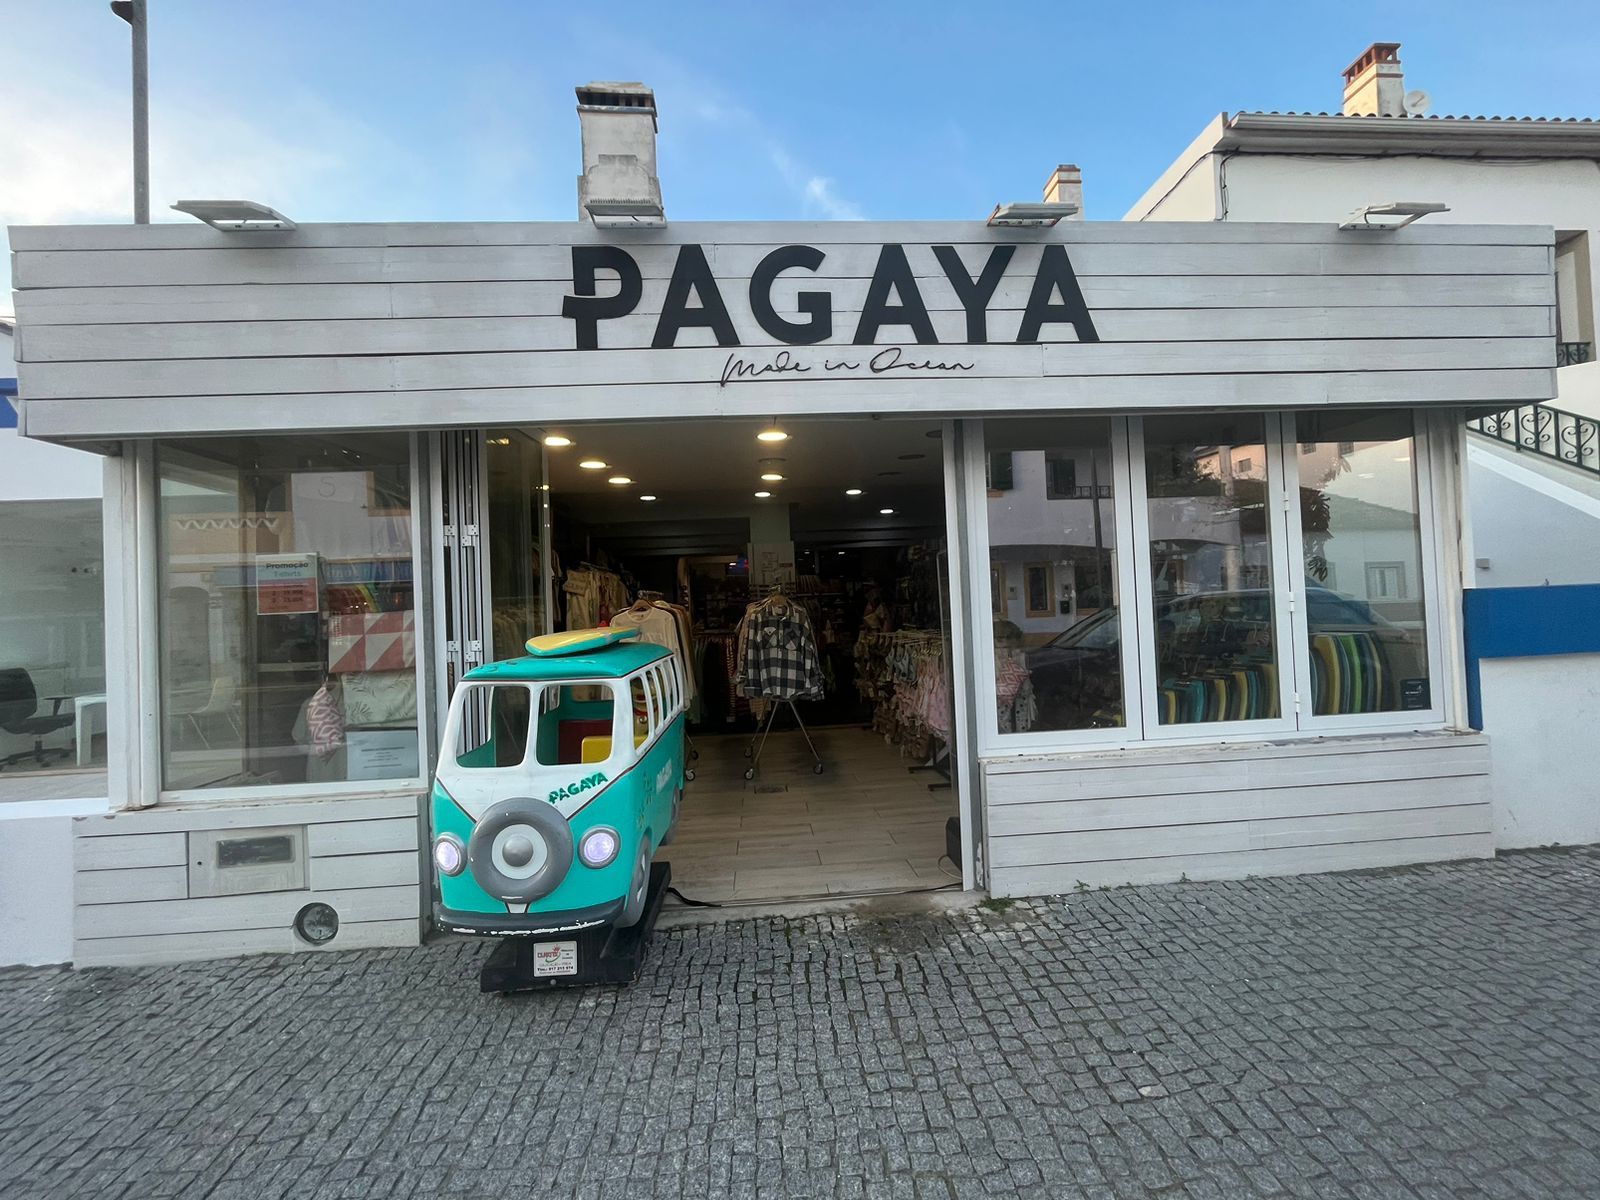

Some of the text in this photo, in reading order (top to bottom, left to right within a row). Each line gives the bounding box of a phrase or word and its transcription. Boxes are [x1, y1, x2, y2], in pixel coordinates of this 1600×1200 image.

[562, 243, 1100, 350] PAGAYA
[720, 347, 975, 388] Made in Ocean
[548, 772, 609, 805] PAGAYA
